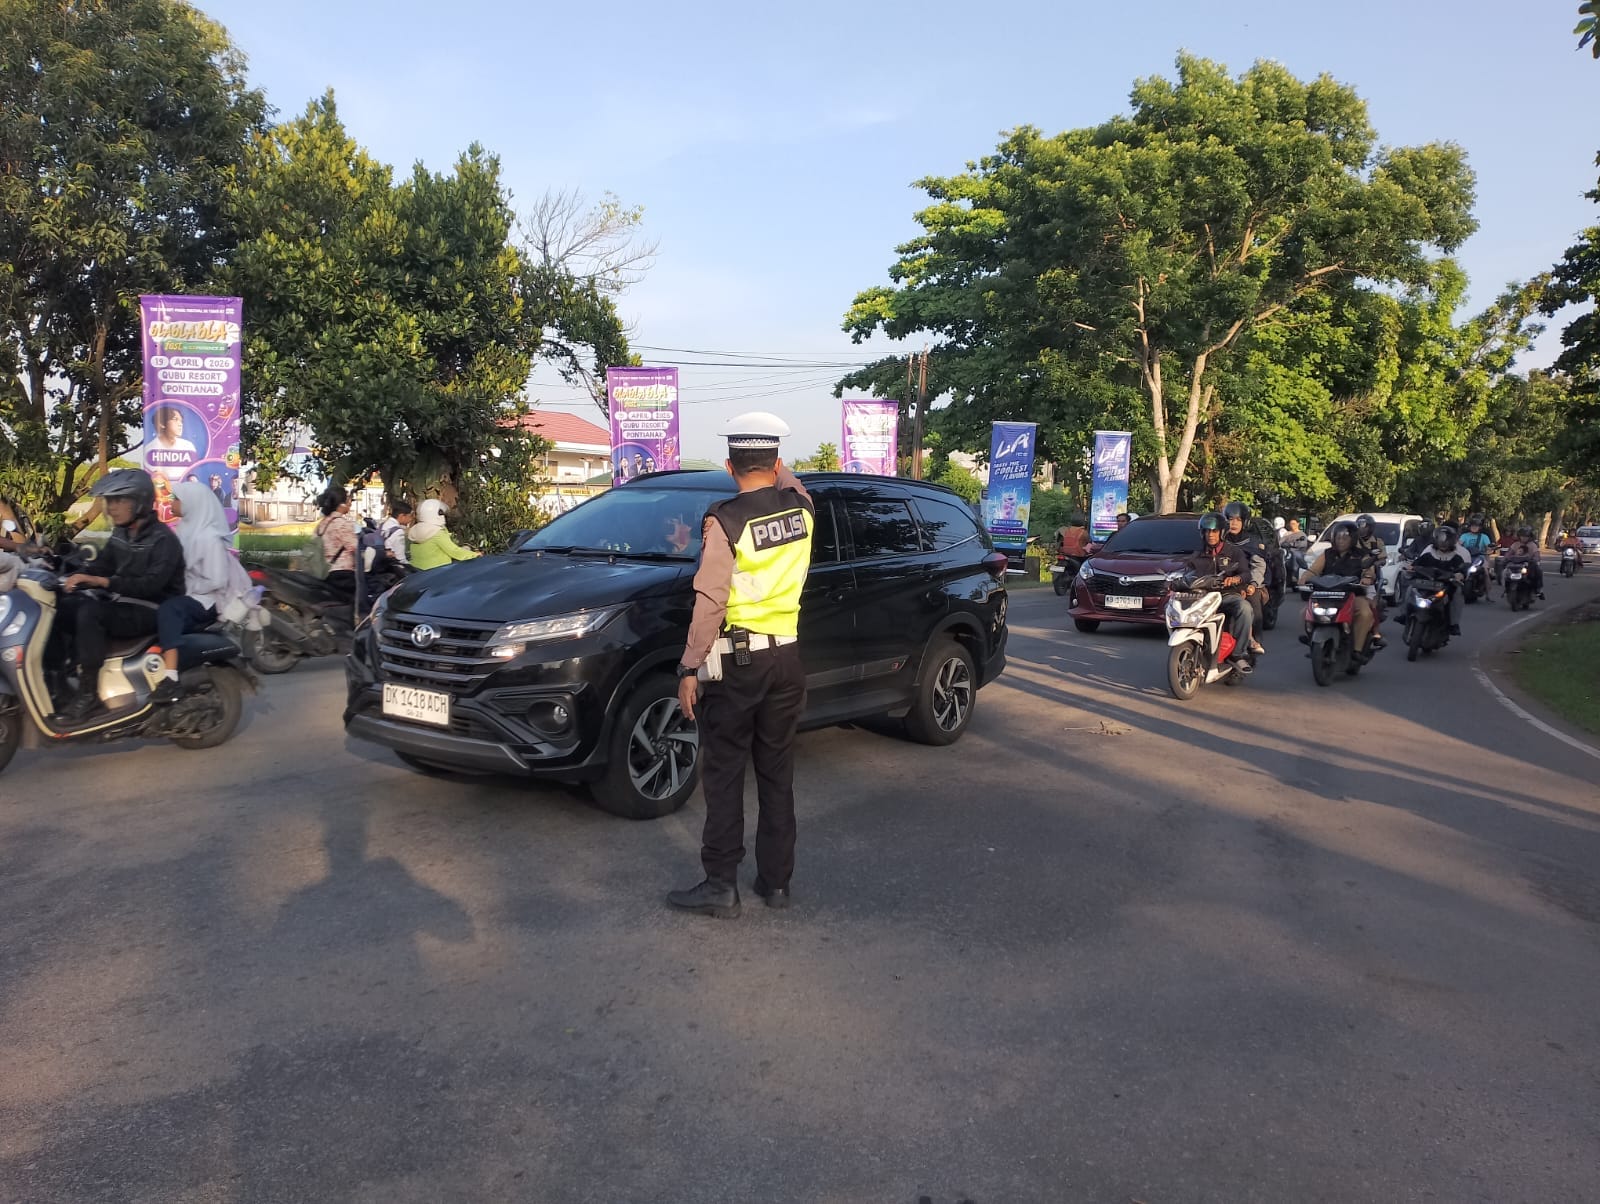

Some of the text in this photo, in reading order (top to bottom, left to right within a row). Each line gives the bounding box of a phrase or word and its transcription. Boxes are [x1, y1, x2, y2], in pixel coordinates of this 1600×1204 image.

[155, 357, 231, 368] 19 APRIL 2026
[162, 371, 222, 381] QUBU RESORT
[166, 384, 219, 394] PONTIANAK
[152, 451, 192, 463] HINDIA
[753, 514, 806, 546] POLISI
[401, 689, 426, 709] 1418
[427, 694, 448, 714] ACH
